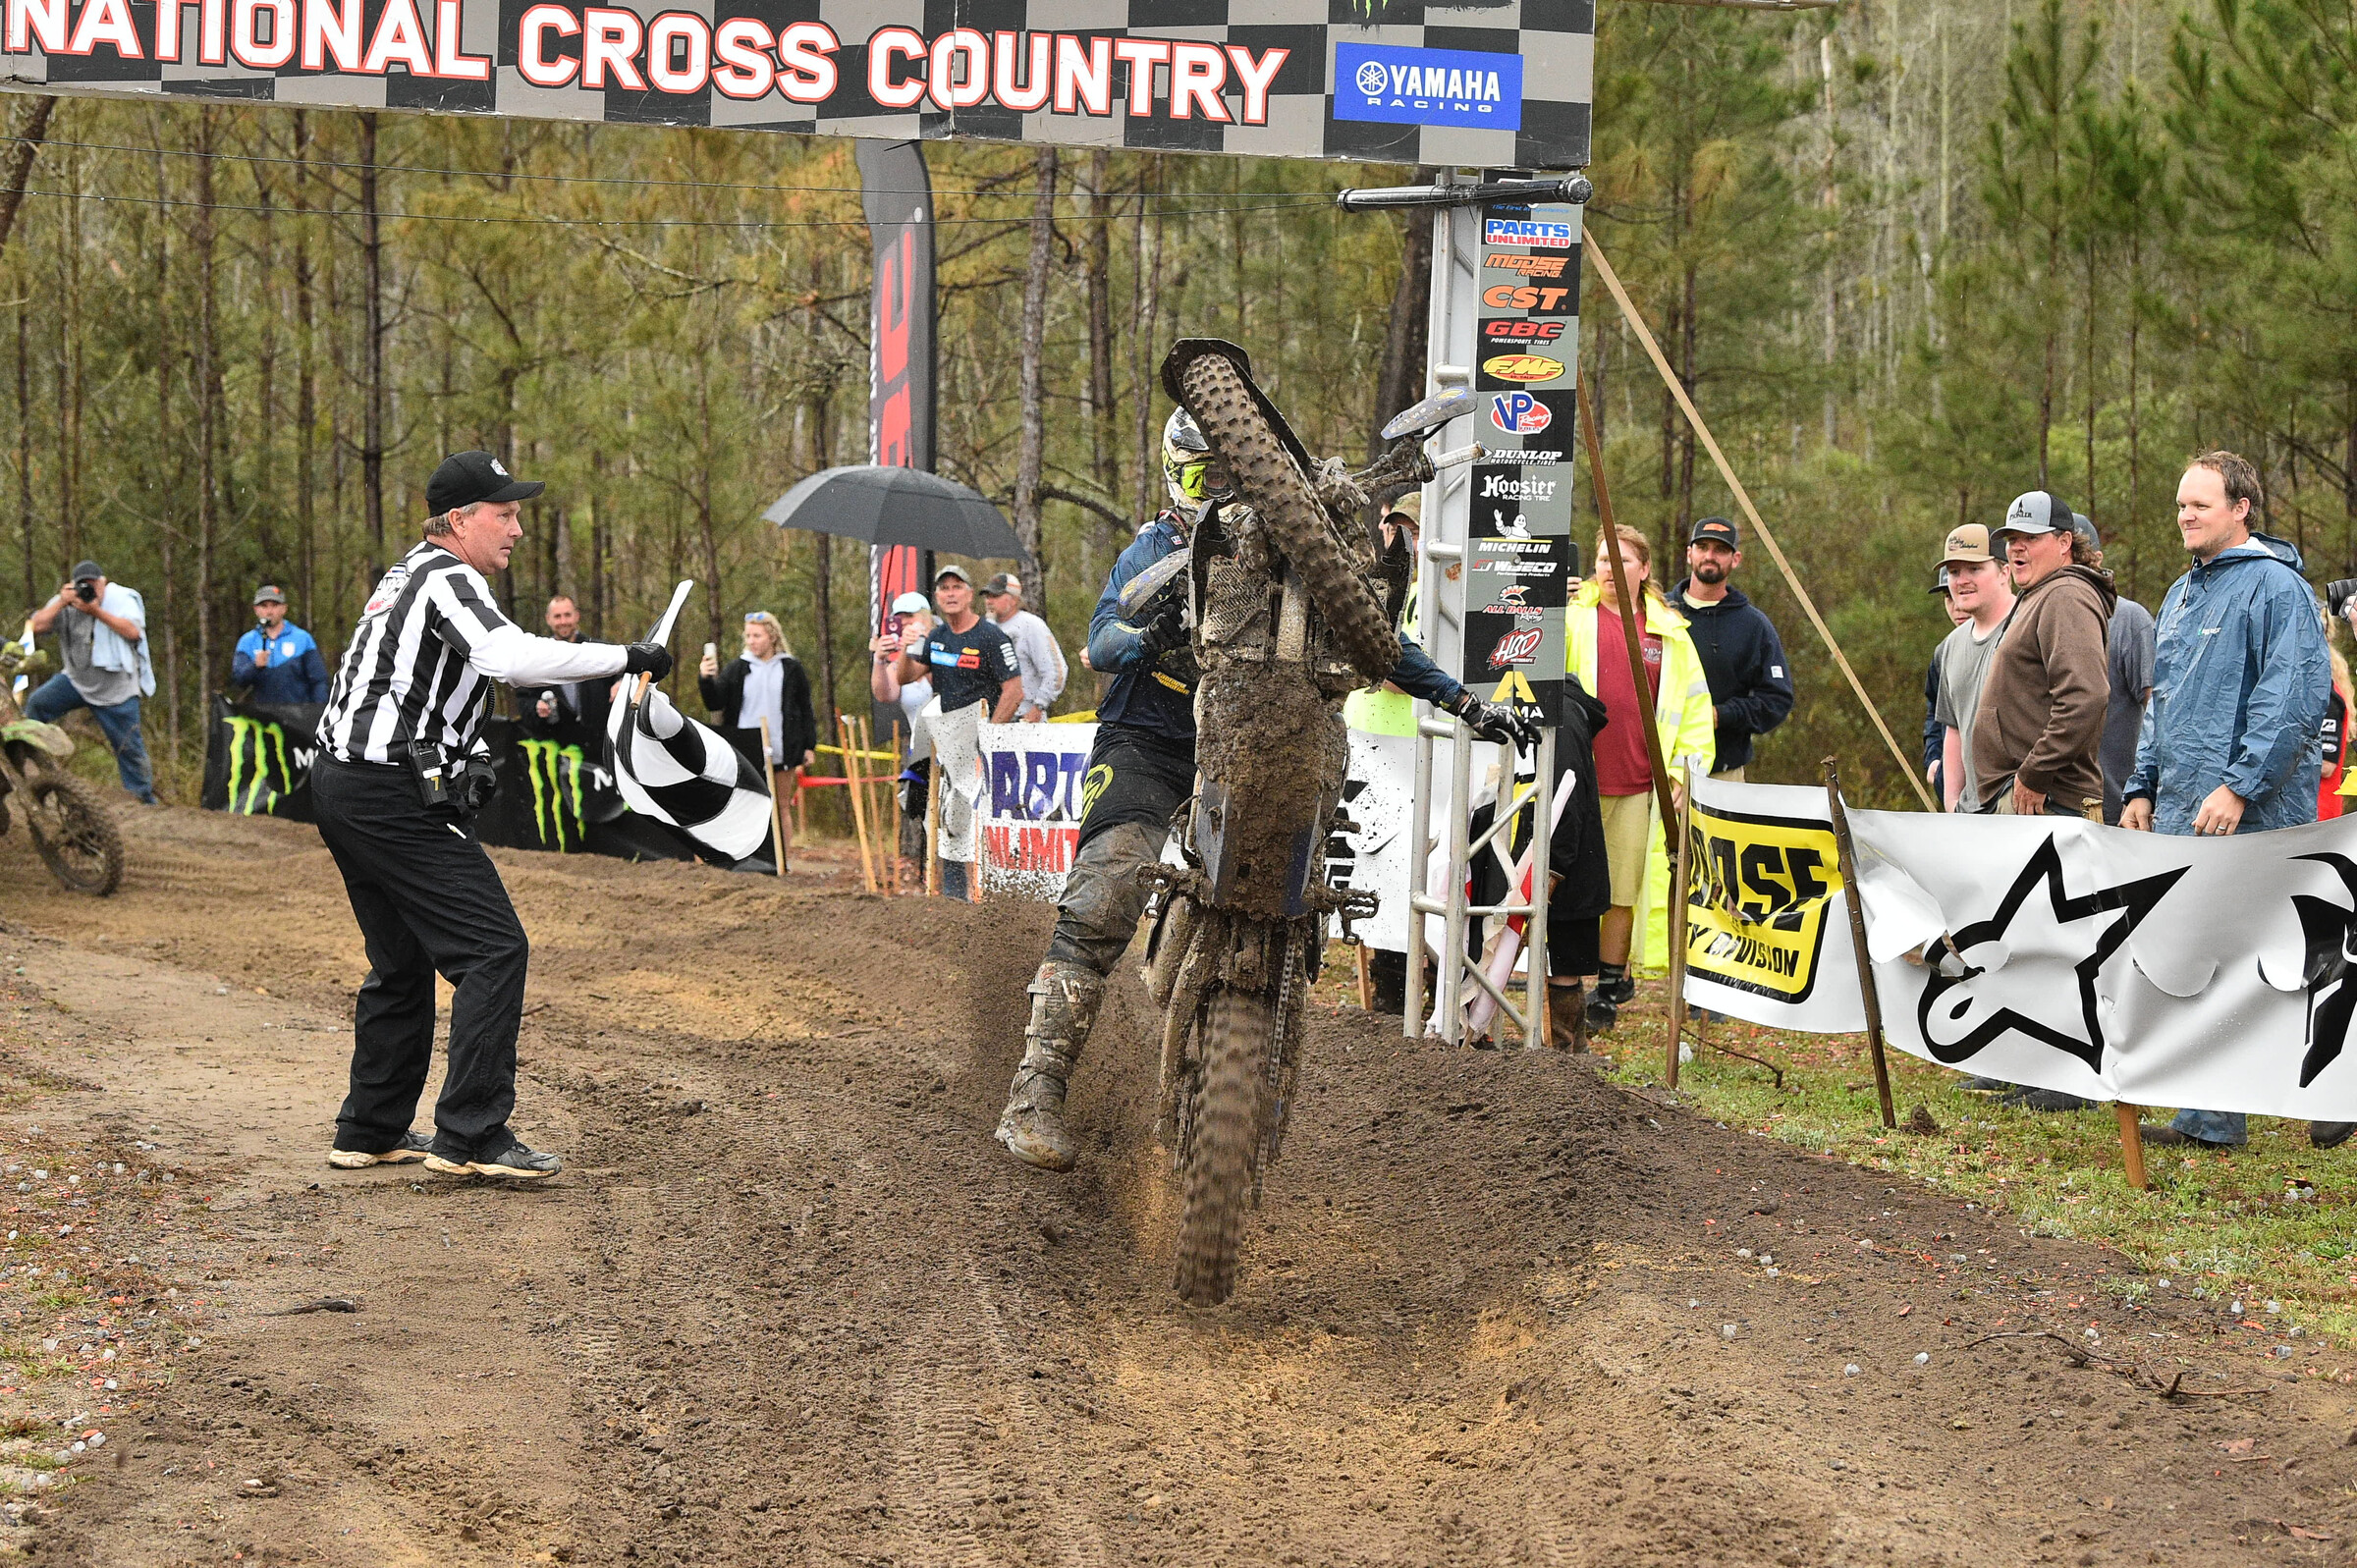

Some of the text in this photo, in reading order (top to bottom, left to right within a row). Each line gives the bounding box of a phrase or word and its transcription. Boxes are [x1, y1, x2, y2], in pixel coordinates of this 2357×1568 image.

[3, 0, 1291, 127] NATIONAL CROSS COUNTRY
[1390, 64, 1502, 102] YAMAHA
[1366, 97, 1494, 113] RACING
[1487, 220, 1569, 238] PARTS
[1486, 235, 1569, 247] UNLIMITED
[1484, 253, 1570, 271] MOOSE
[1515, 269, 1562, 278] RACING
[1483, 285, 1569, 310] CST
[1485, 320, 1565, 339] GBC
[1490, 337, 1532, 346] POWERSPORTS
[1483, 357, 1564, 375] FMF
[1494, 393, 1533, 432] VP
[1490, 458, 1534, 466] MOTORCYCLE
[1492, 448, 1562, 460] DUNLOP
[1479, 473, 1557, 498] Hoosier
[1478, 541, 1552, 554] MICHELIN
[1482, 604, 1545, 616] ALL BALLS
[430, 776, 440, 791] 7
[980, 750, 1091, 822] ART
[1688, 825, 1829, 932] OOSE
